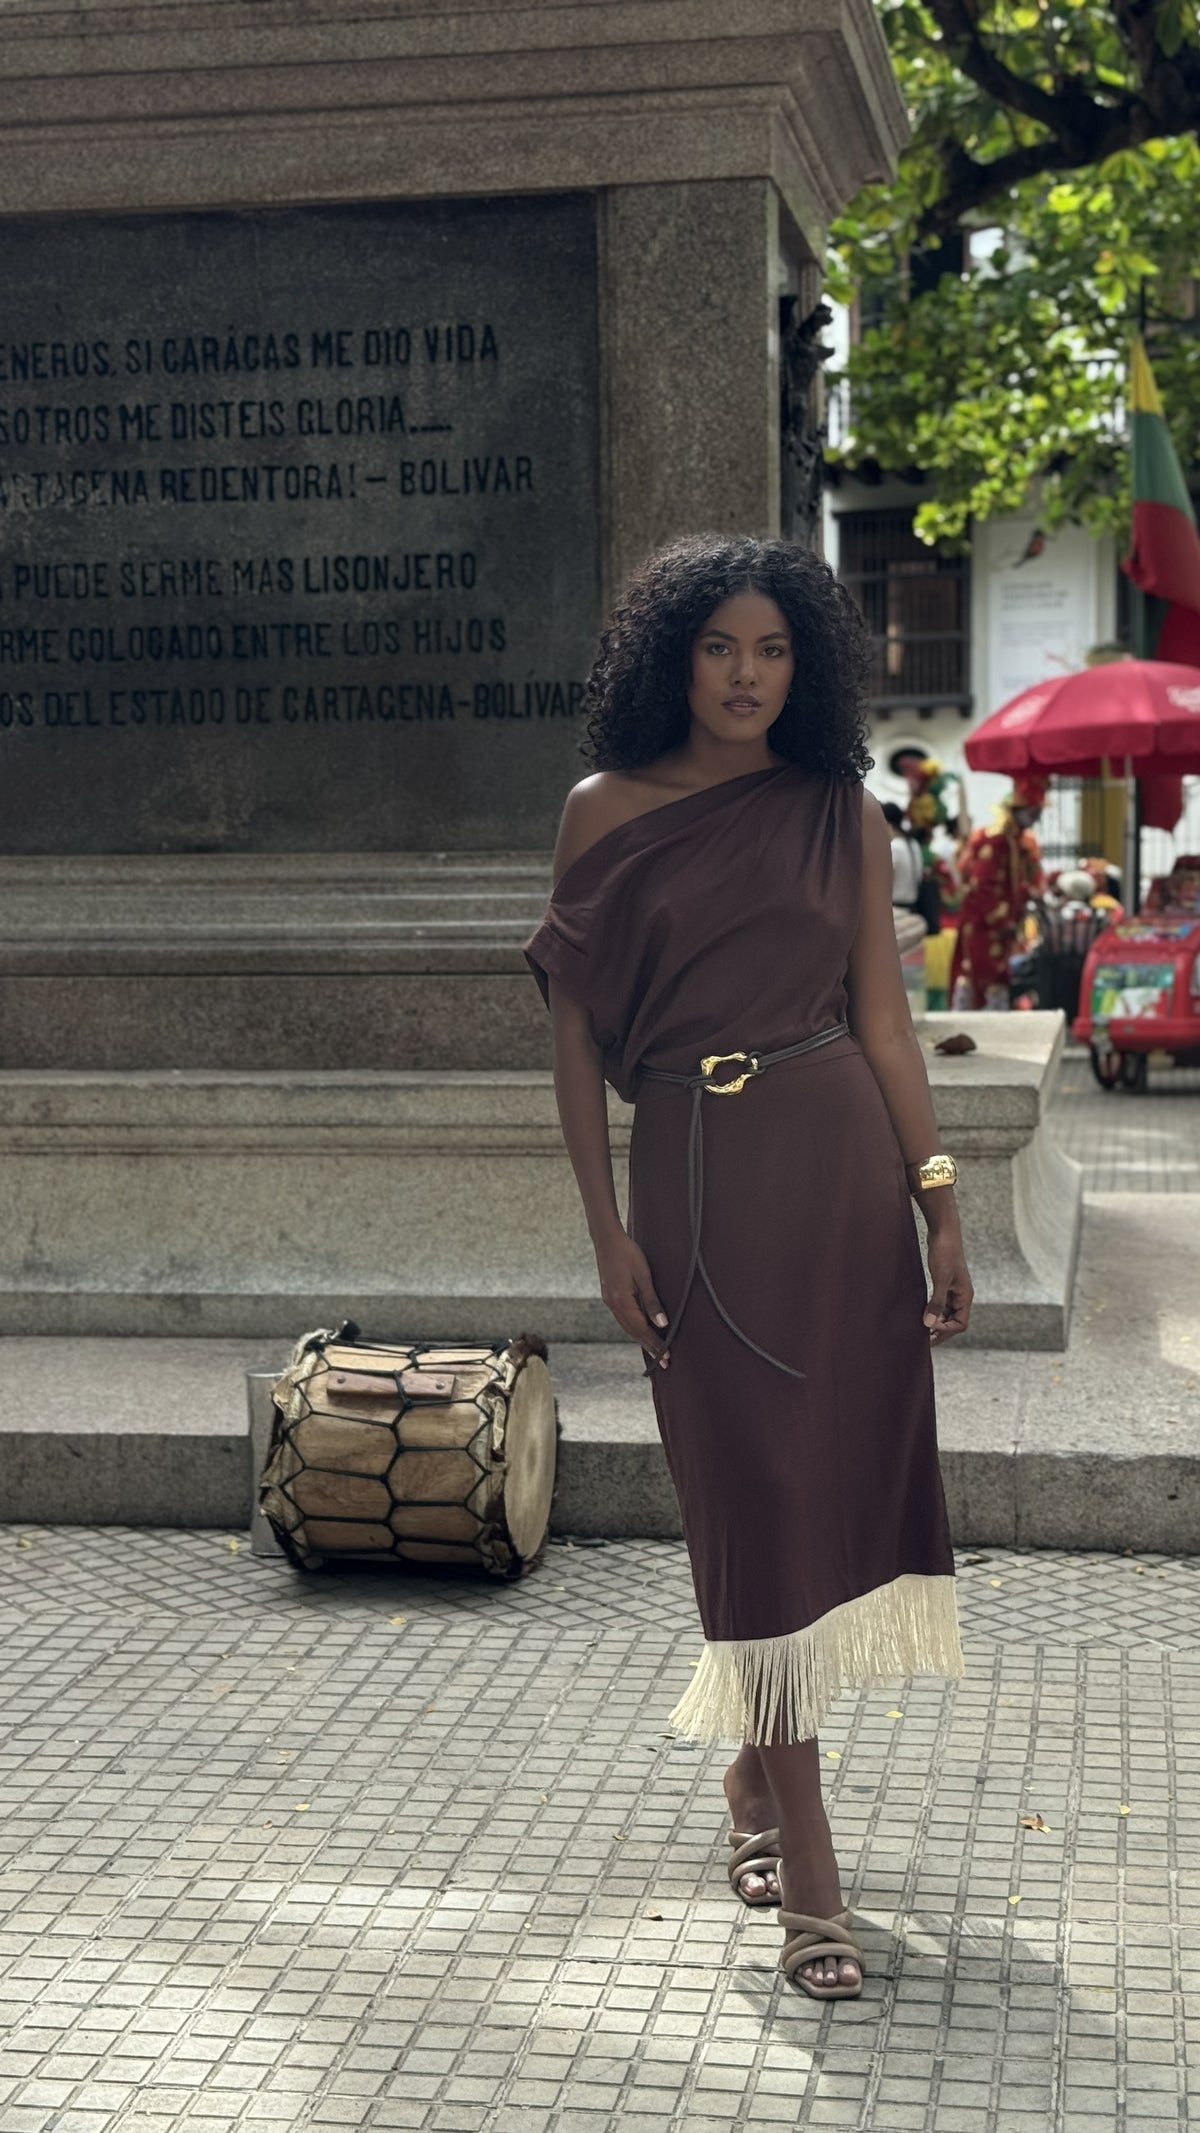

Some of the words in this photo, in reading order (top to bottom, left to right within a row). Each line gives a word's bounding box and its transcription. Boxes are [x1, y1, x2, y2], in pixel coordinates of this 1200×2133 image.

[124, 338, 152, 376] SI
[311, 329, 354, 369] ME
[364, 326, 412, 367] DIO
[423, 323, 499, 364] VIDA
[118, 402, 163, 442] ME
[170, 399, 285, 439] DISTEIS
[400, 456, 535, 497] BOLIVAR
[15, 562, 109, 600] PUEDE
[119, 560, 223, 597] SERME
[232, 557, 294, 596] MAS
[304, 552, 477, 594] LISONJERO
[68, 623, 223, 663] COLOCADO
[232, 621, 333, 658] ENTRE
[343, 620, 401, 656] LOS
[413, 617, 508, 655] HIJOS
[45, 690, 101, 727] DEL
[109, 686, 225, 726] ESTADO
[236, 686, 272, 723] DE
